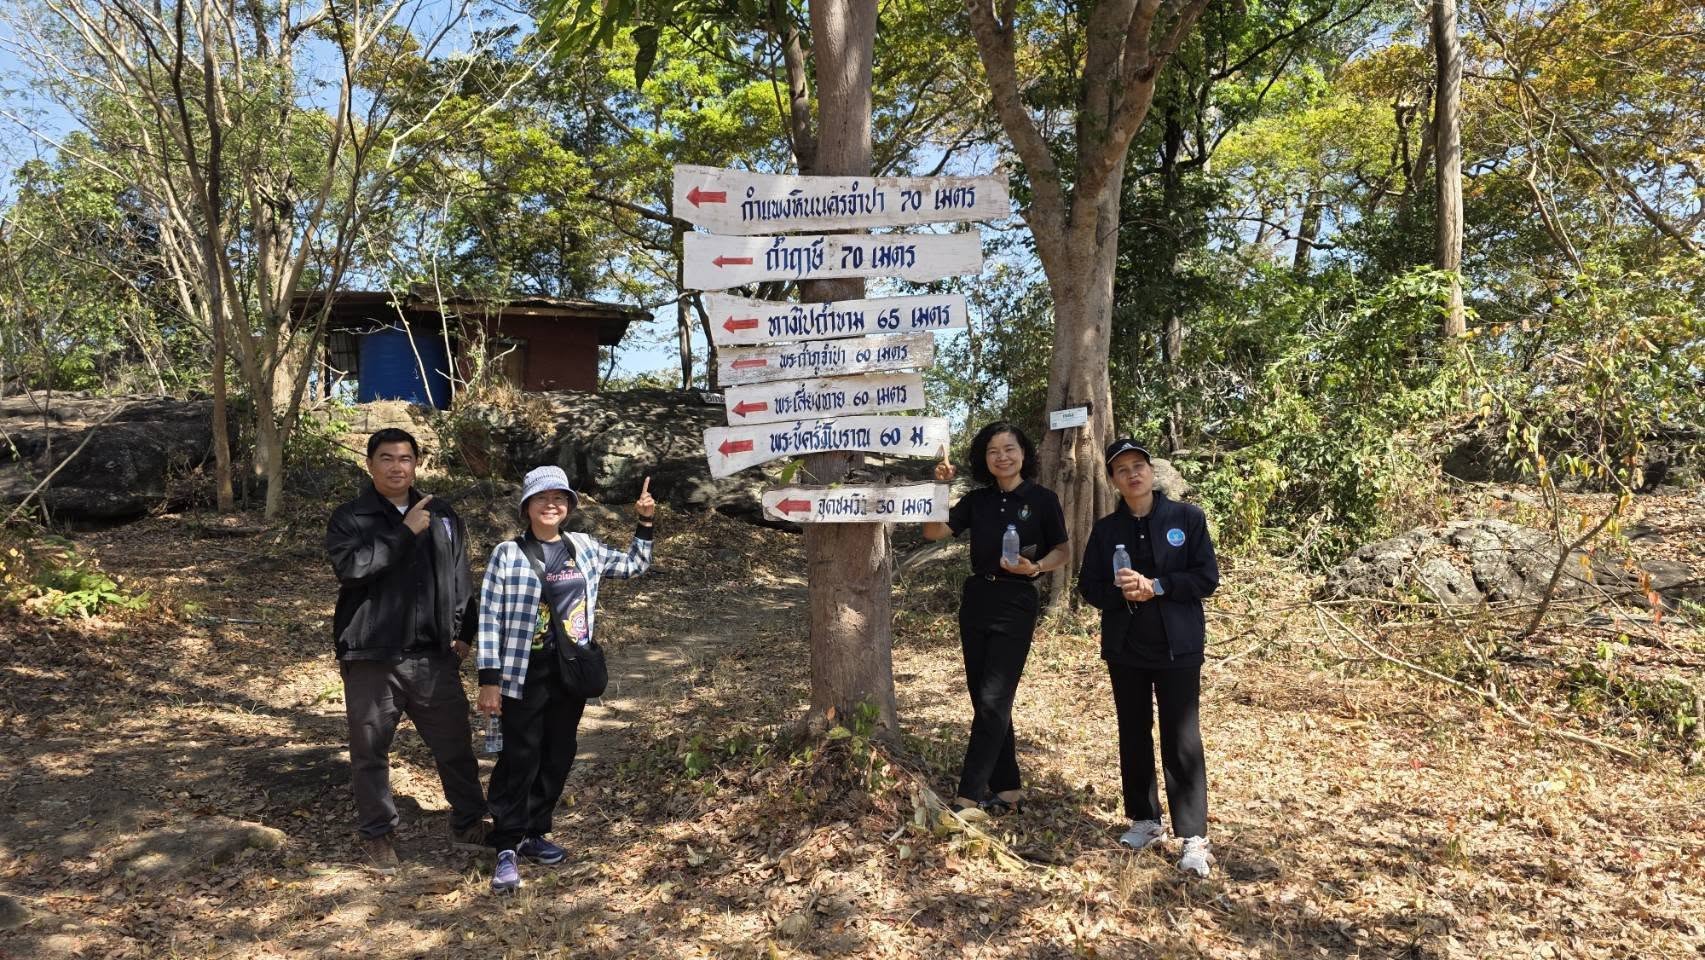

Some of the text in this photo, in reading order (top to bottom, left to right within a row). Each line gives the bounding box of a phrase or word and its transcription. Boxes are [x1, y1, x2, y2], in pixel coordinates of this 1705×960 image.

[900, 190, 922, 212] 70
[934, 186, 976, 210] เมตร
[841, 246, 864, 269] 70
[871, 245, 917, 269] เมตร
[877, 308, 901, 330] 65
[910, 304, 951, 328] เมตร
[855, 348, 871, 363] 60
[877, 344, 908, 362] เมตร
[853, 391, 869, 406] 60
[877, 385, 907, 406] เมตร
[880, 428, 901, 447] 60
[910, 426, 929, 449] ม.
[876, 499, 895, 514] 30
[901, 498, 933, 516] เมตร
